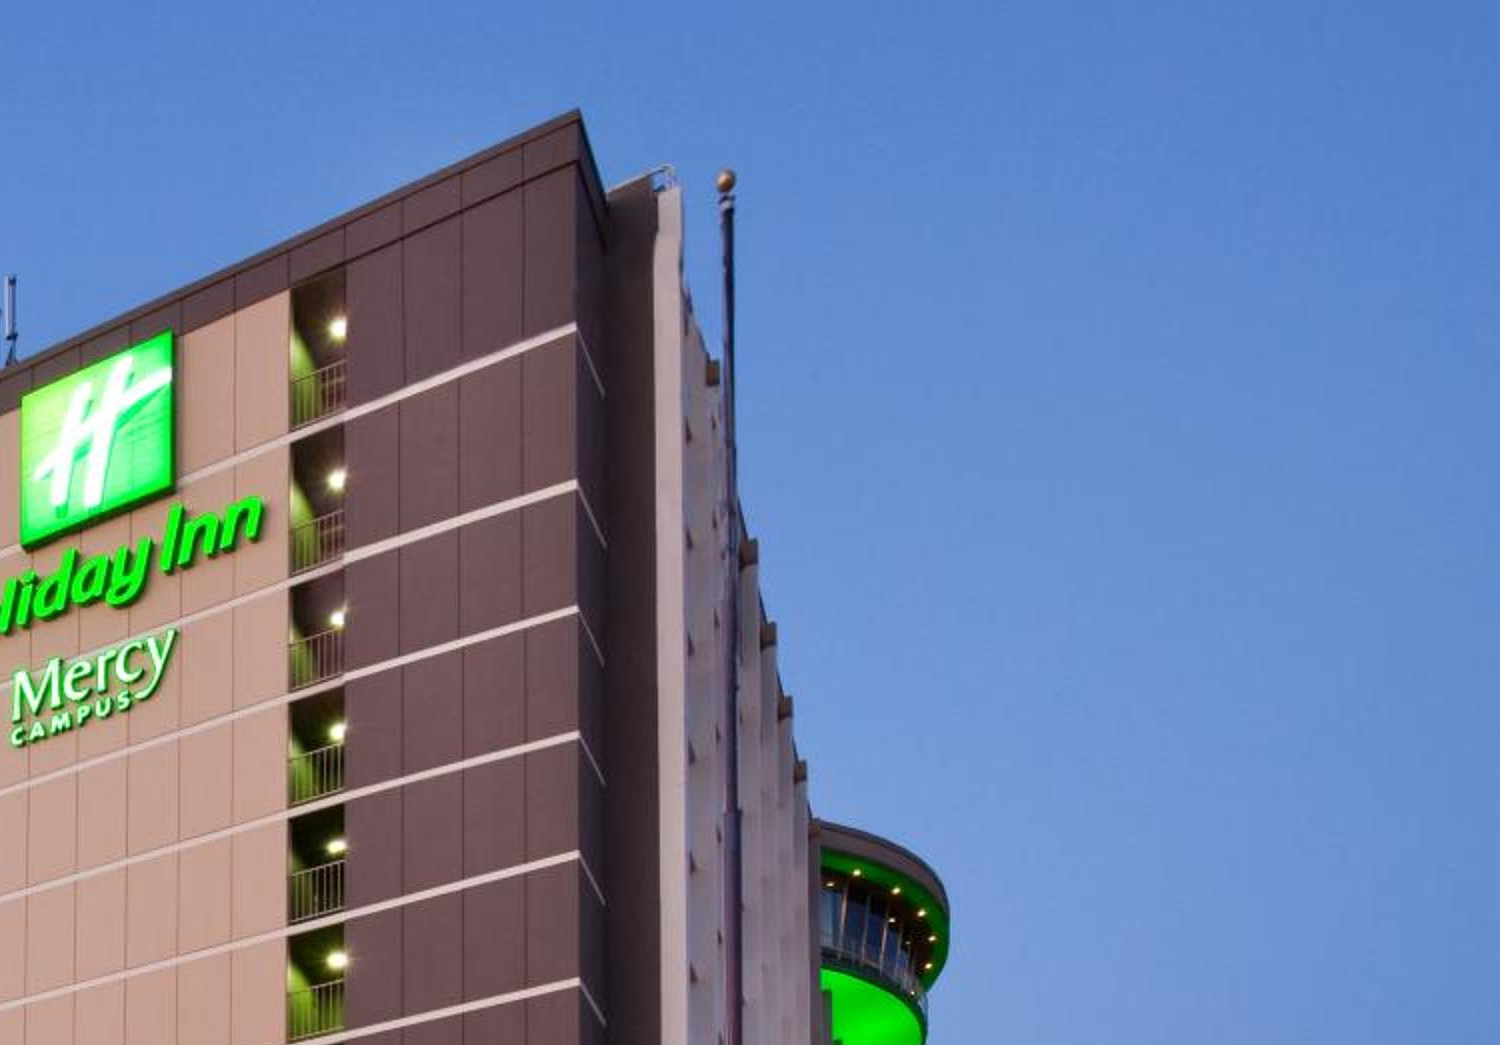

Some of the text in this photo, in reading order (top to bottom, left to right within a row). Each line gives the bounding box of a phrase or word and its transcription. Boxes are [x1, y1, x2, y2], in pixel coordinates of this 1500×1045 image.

[159, 495, 264, 576] Inn
[12, 627, 180, 724] Mercy
[9, 690, 133, 747] CAMPUS
